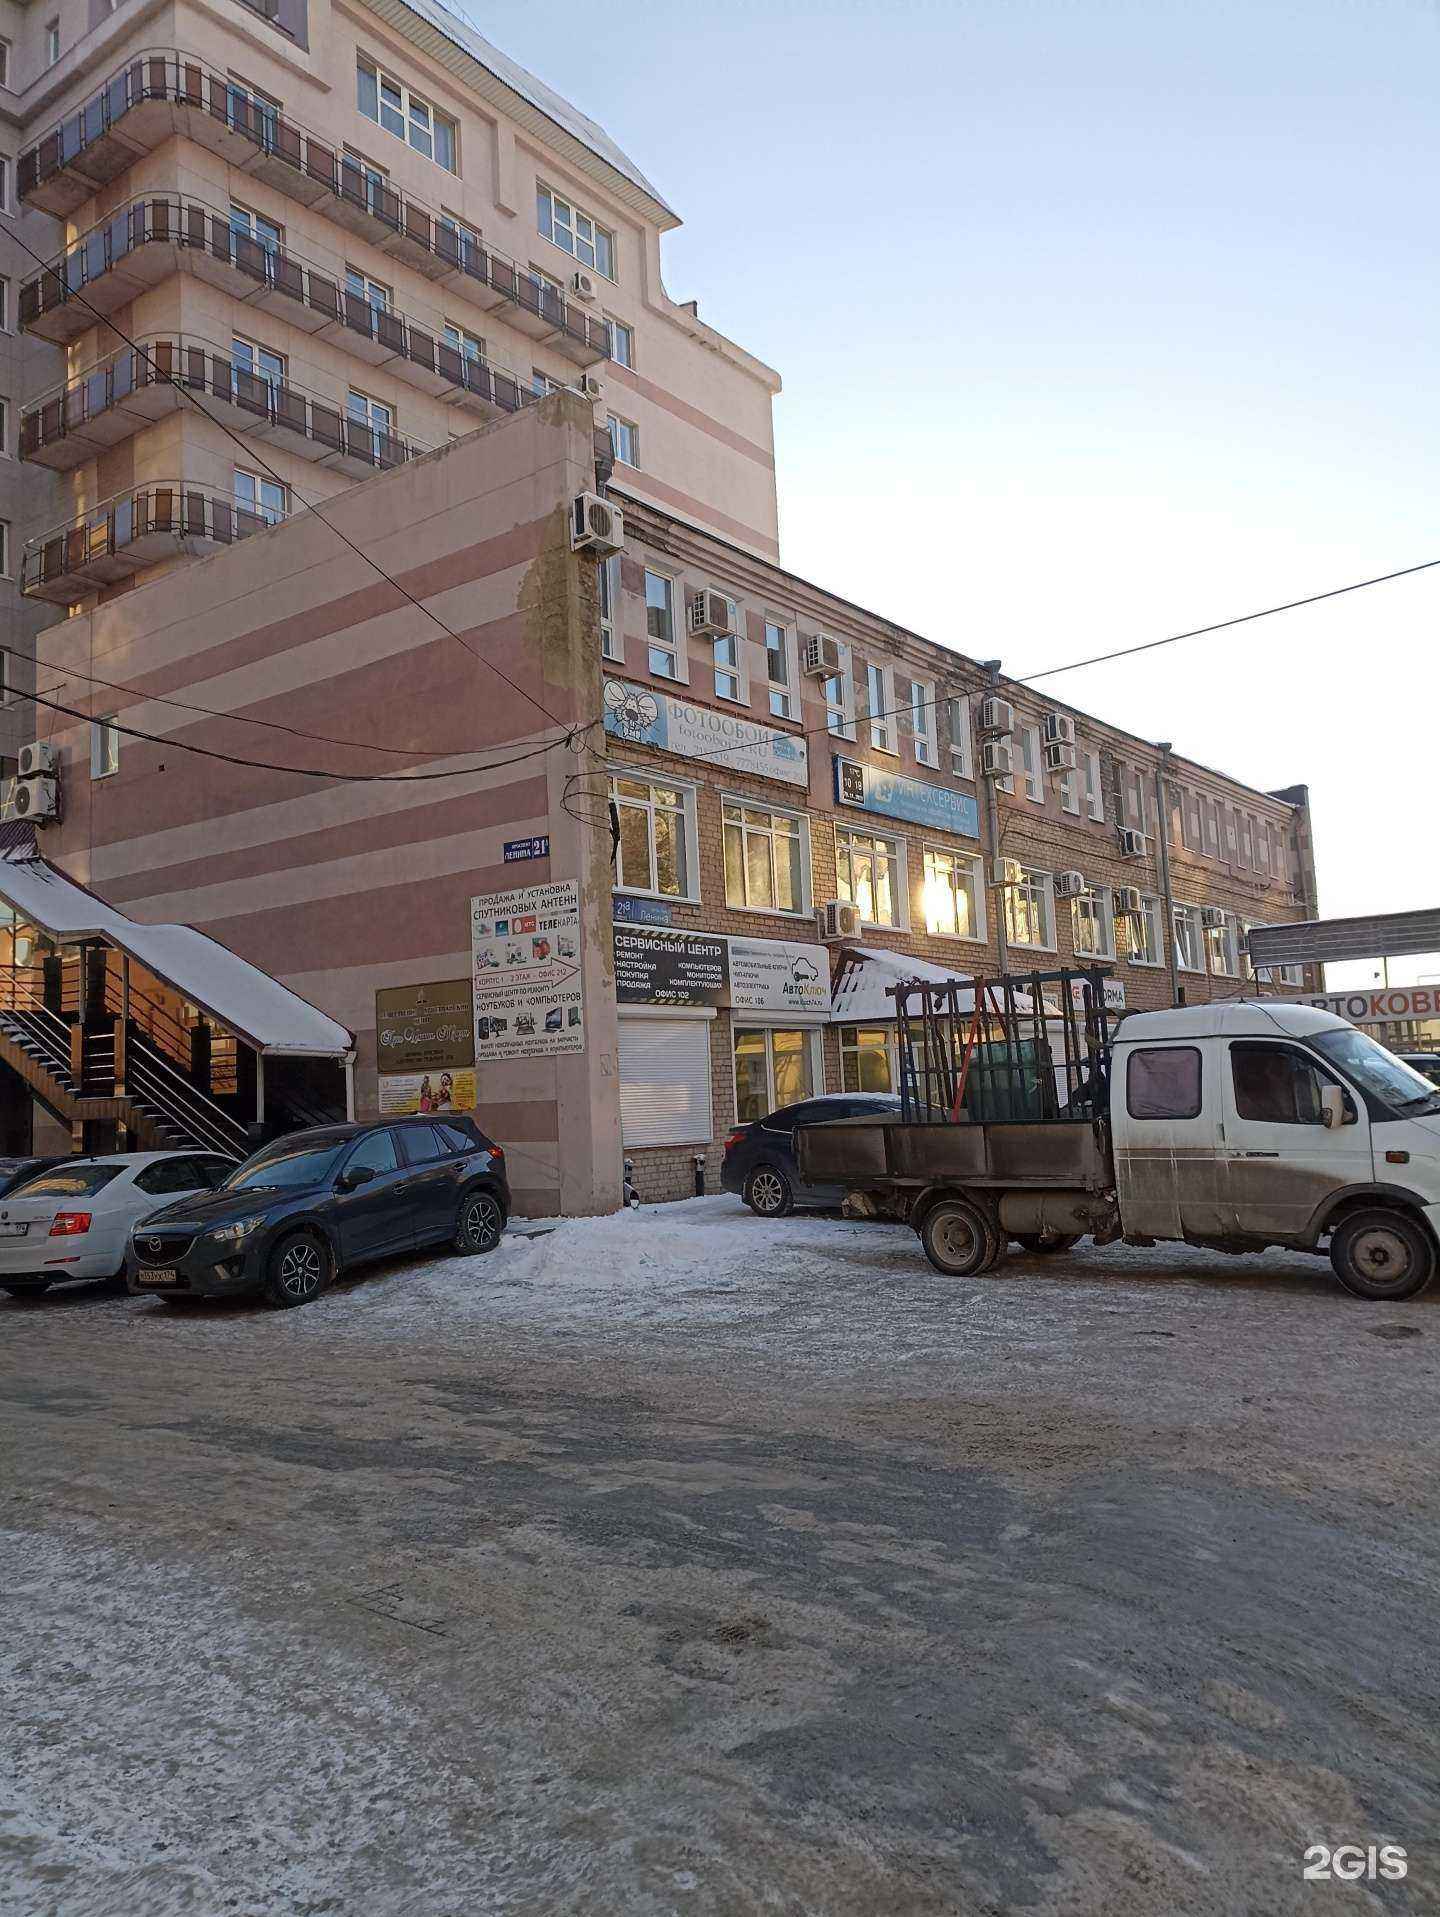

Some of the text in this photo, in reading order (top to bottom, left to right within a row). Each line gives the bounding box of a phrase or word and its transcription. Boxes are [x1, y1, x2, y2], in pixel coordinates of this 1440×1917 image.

[479, 894, 515, 906] ПРОДАЖА
[528, 883, 571, 898] УСТАНОВКА
[473, 903, 537, 920] СПУТНИКОВЫХ
[541, 895, 577, 909] АНТЕНН
[615, 935, 685, 953] СЕРВИСНЫЙ
[688, 944, 722, 957] ЦЕНТР
[617, 951, 644, 959] РЕМОНТ
[617, 961, 657, 971] НАСТРОЙКА
[617, 970, 649, 979] ПОКУПКА
[617, 980, 651, 989] ПРОДАЖА
[782, 982, 826, 995] АвтоКлюч
[655, 989, 690, 999] ОФИС 102
[476, 1000, 515, 1011] НОУТБУКОВ
[526, 992, 581, 1005] КОМПЬЮТЕРОВ
[735, 996, 753, 1004] ОФИС
